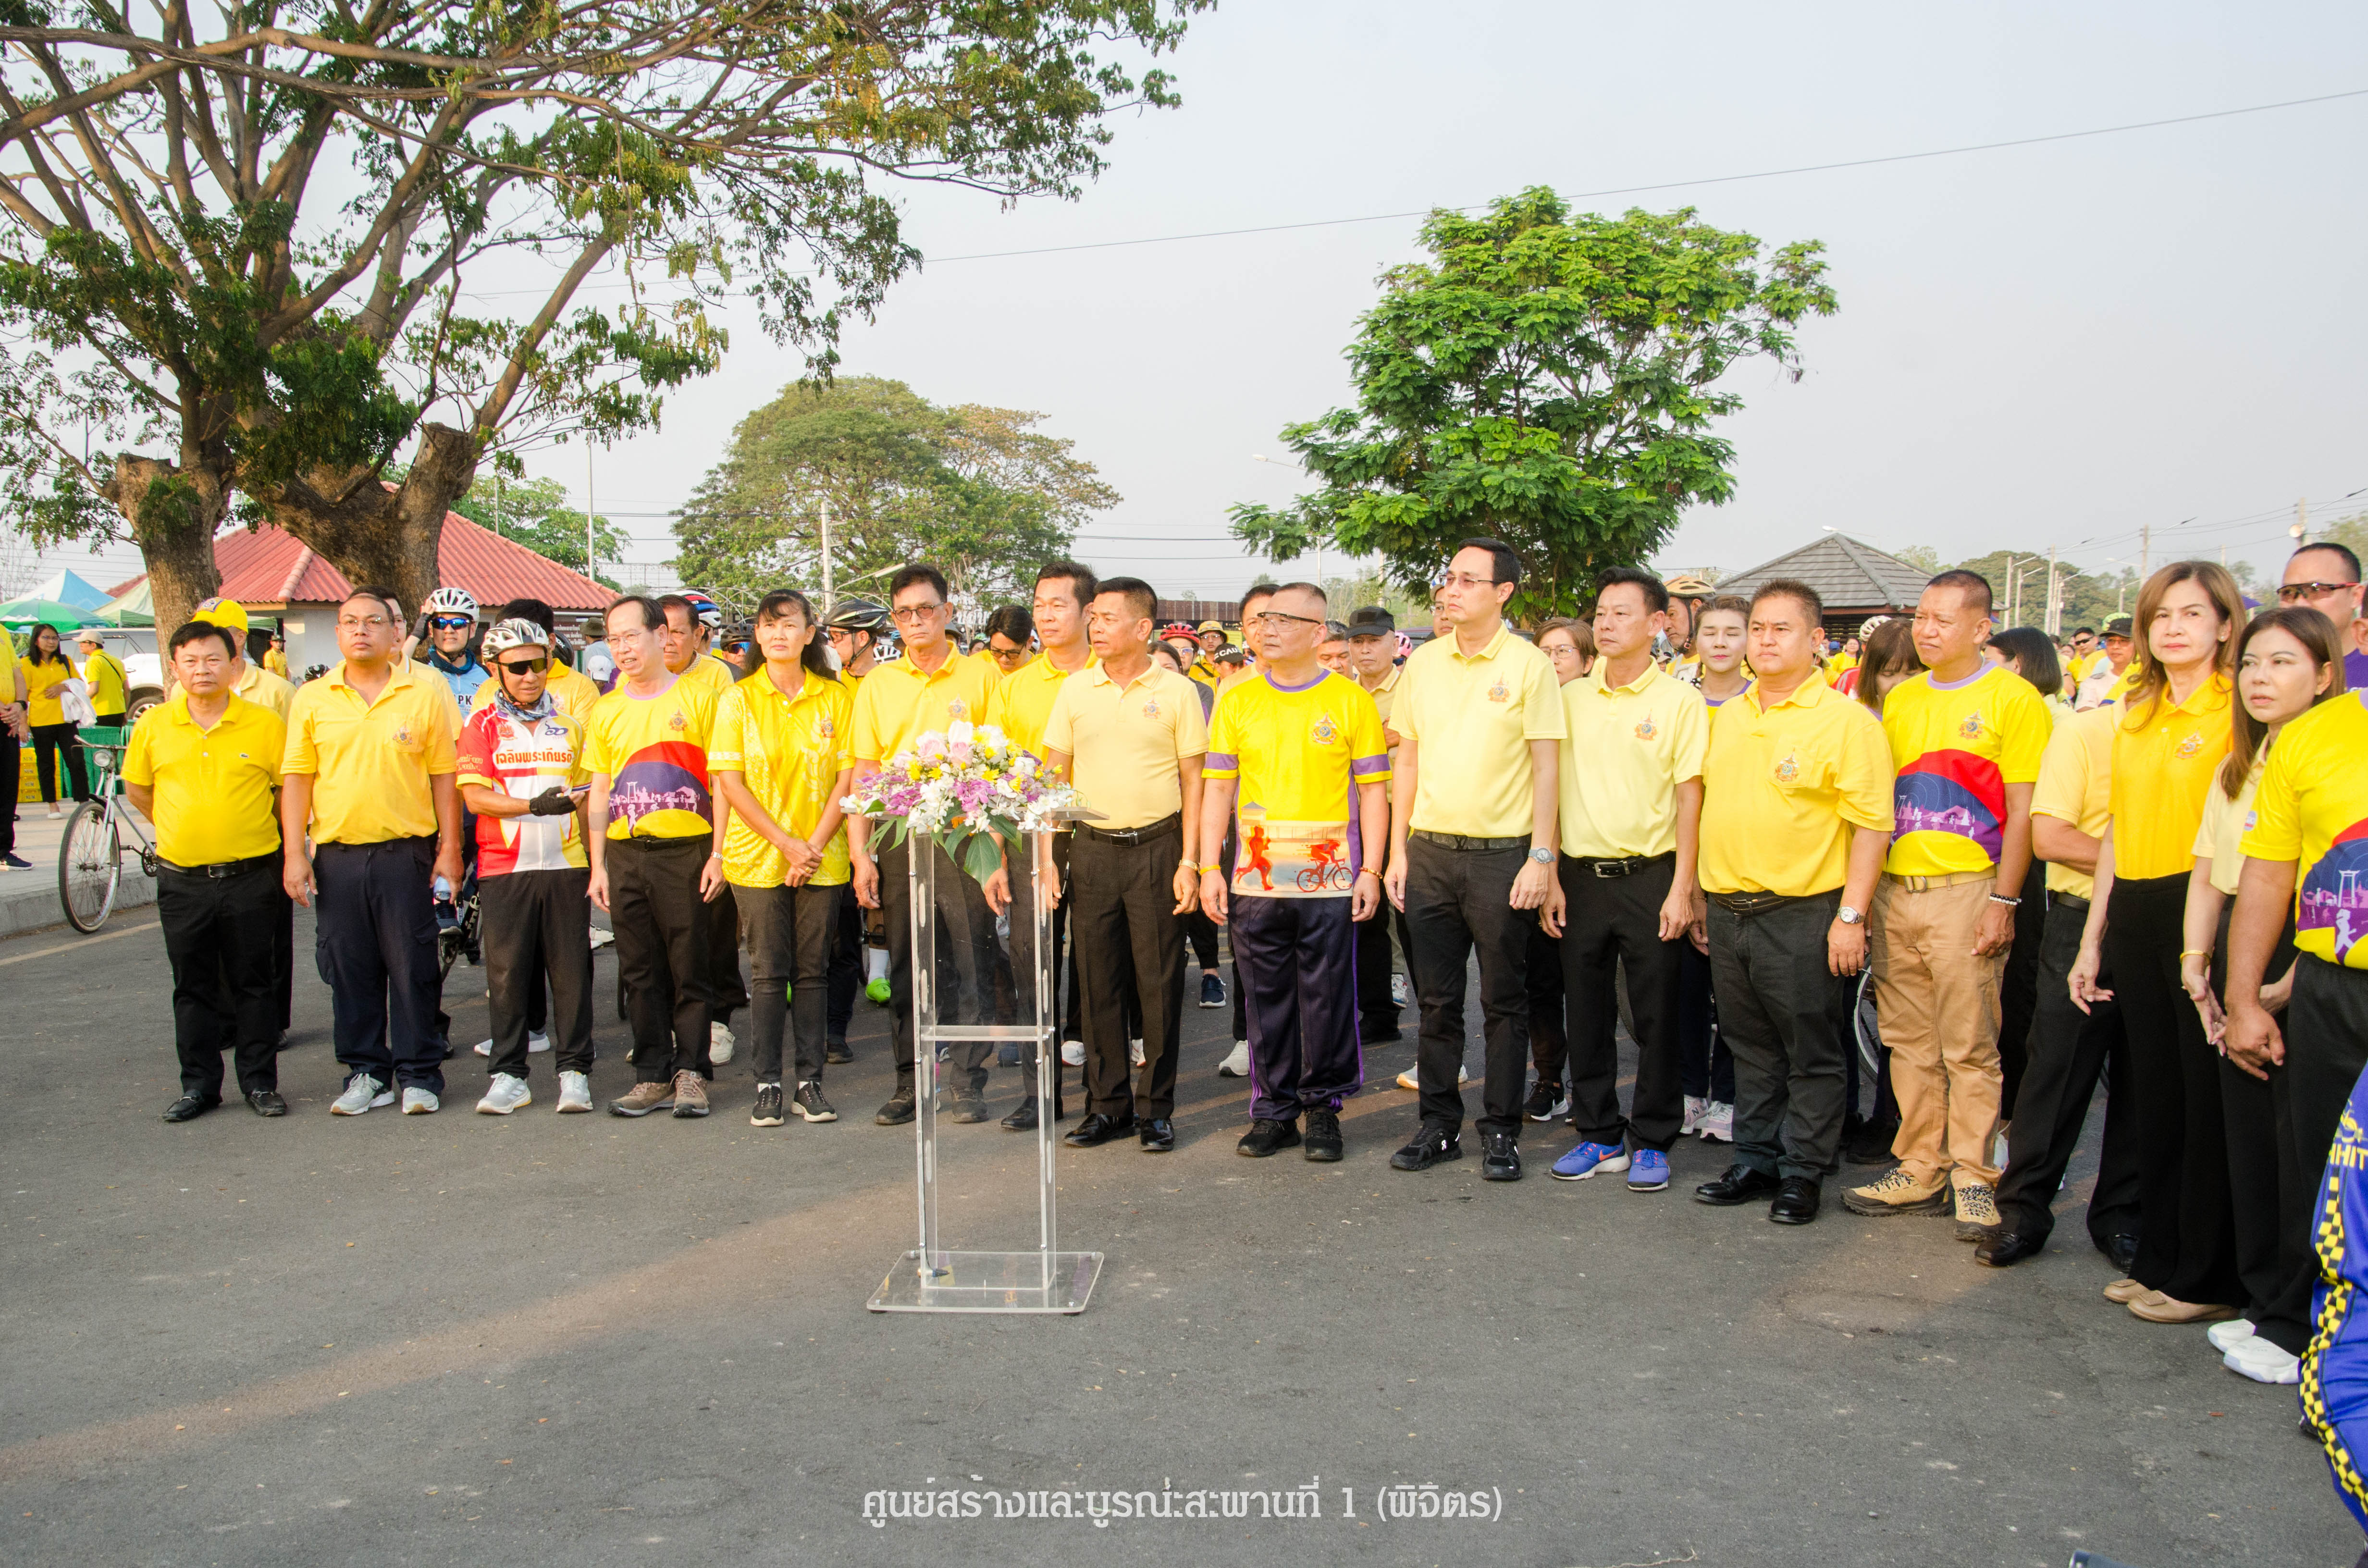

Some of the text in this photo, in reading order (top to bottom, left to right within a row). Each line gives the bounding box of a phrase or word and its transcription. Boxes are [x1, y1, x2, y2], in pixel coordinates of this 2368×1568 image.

[555, 636, 566, 649] OX
[454, 695, 472, 705] PK
[495, 747, 574, 764] เฉลิมพระเกียรติ
